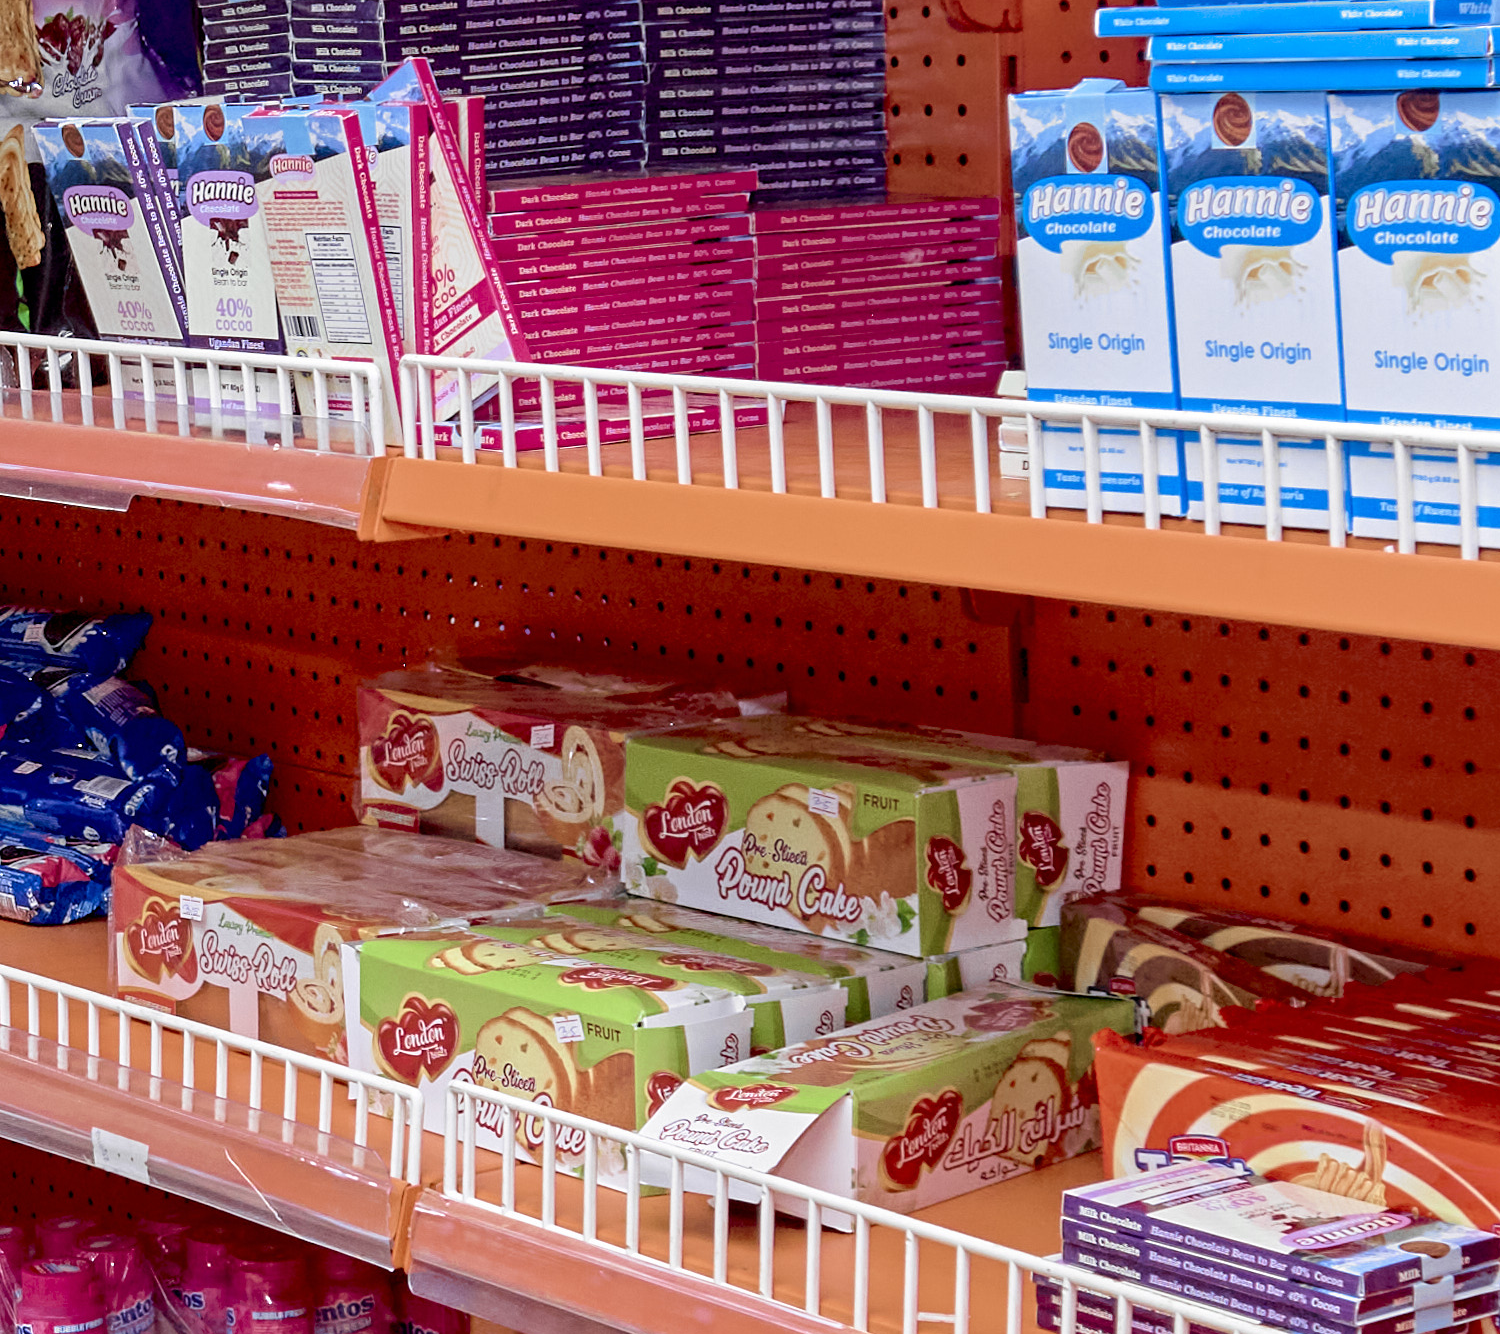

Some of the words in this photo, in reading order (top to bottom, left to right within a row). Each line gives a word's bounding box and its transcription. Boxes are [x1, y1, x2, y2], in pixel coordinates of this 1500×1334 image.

[678, 127, 714, 138] Chocolate
[680, 145, 716, 155] Chocolate
[191, 180, 254, 206] Hannie
[520, 195, 541, 204] Dark
[543, 192, 579, 202] Chocolate
[612, 186, 649, 195] Chocolate
[1030, 179, 1146, 221] Hannie
[1185, 180, 1312, 225] Hannie
[69, 193, 127, 217] Hannie
[200, 204, 240, 214] Chocolate
[1355, 186, 1493, 229] Hannie
[515, 219, 534, 228] Dark
[536, 216, 572, 226] Chocolate
[1045, 221, 1117, 235] Chocolate
[1203, 225, 1282, 240] Chocolate
[1374, 230, 1459, 246] Chocolate
[519, 266, 538, 275] Dark
[540, 262, 577, 273] Chocolate
[117, 301, 152, 320] 40%
[216, 298, 253, 318] 40%
[120, 320, 155, 333] cocoa
[215, 318, 253, 333] cocoa
[209, 338, 239, 350] Ugandan
[241, 341, 265, 351] Finest
[1047, 332, 1094, 351] Single
[1098, 333, 1146, 353] Origin
[1205, 339, 1256, 361] Single
[1259, 341, 1312, 363] Origin
[1374, 350, 1428, 372] Single
[1433, 352, 1489, 376] Origin
[1099, 395, 1133, 407] Finest
[445, 738, 499, 784] Swiss
[499, 747, 545, 798] Roll
[862, 793, 899, 813] FRUIT
[659, 800, 714, 840] London
[743, 829, 809, 868] Pre-Sliced
[715, 847, 793, 915] Pound
[797, 870, 863, 924] Cake
[139, 923, 182, 960] London
[200, 930, 253, 979] Swiss
[253, 943, 298, 993] Roll
[394, 1019, 446, 1056] London
[586, 1021, 621, 1043] FRUIT
[473, 1055, 538, 1094] Pre-Sliced
[659, 1118, 721, 1147] Pound
[714, 1129, 768, 1155] Cake
[1175, 1141, 1221, 1155] BRITANNIA
[1078, 1229, 1096, 1244] Milk
[1098, 1235, 1141, 1258] Chocolate
[1078, 1205, 1098, 1220] Milk
[1100, 1210, 1143, 1232] Chocolate
[1150, 1224, 1182, 1243] Hannie
[1184, 1233, 1229, 1255] Chocolate
[1231, 1243, 1255, 1260] Bean
[1257, 1250, 1268, 1261] to
[1269, 1255, 1287, 1272] Bar
[1314, 1270, 1345, 1289] Cocoa
